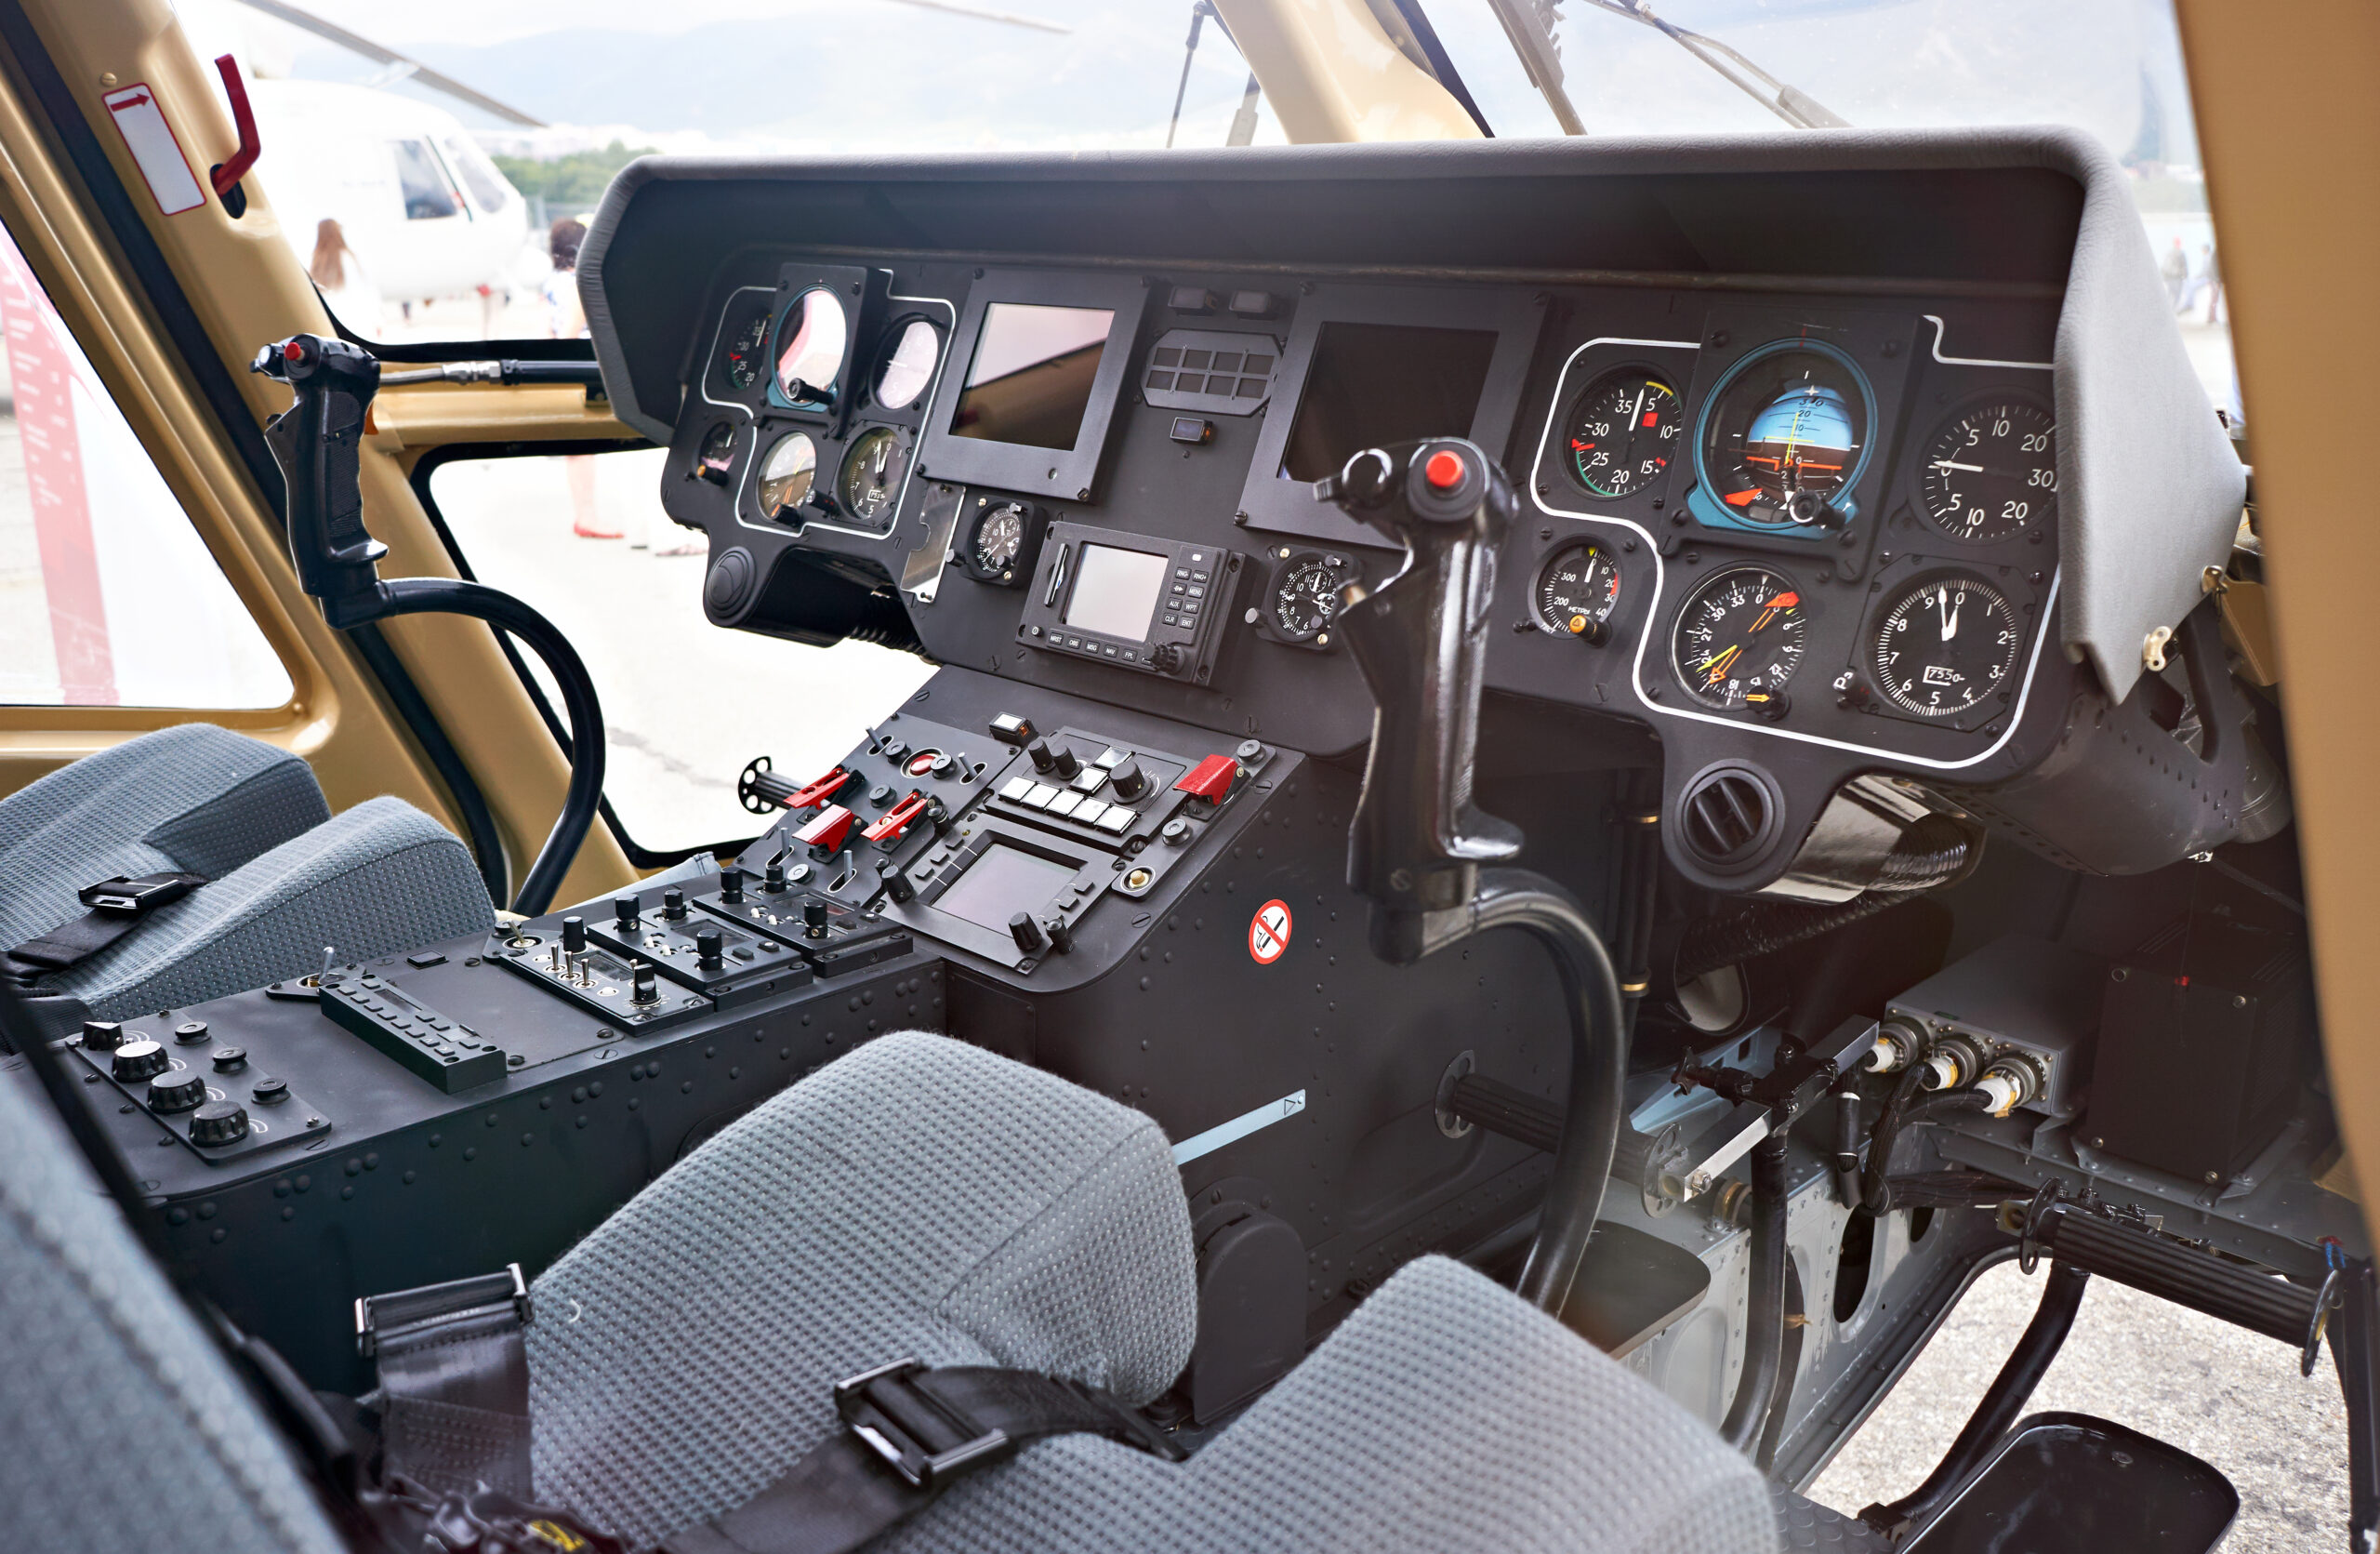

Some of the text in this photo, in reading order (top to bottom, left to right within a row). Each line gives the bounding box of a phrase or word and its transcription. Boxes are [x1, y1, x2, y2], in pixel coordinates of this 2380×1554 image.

[1615, 400, 1633, 414] 35
[1646, 398, 1656, 411] 5
[1592, 423, 1609, 436] 30
[1659, 425, 1673, 439] 10
[1992, 419, 2010, 436] 10
[1965, 429, 1980, 445] 5
[2020, 433, 2047, 452] 20
[860, 461, 866, 470] 8
[1591, 452, 1610, 466] 25
[1641, 460, 1654, 474] 15
[1610, 470, 1630, 484] 20
[2028, 469, 2054, 487] 30
[854, 482, 860, 490] 7
[1948, 494, 1963, 511] 5
[868, 506, 874, 514] 5
[2002, 500, 2029, 519] 20
[1966, 508, 1985, 525] 10
[1601, 566, 1609, 575] 10
[1561, 573, 1577, 582] 300
[1605, 578, 1614, 588] 20
[1296, 583, 1303, 591] 10
[1554, 596, 1569, 606] 200
[1605, 593, 1615, 602] 30
[1730, 595, 1745, 607] 33
[1755, 594, 1764, 604] 0
[1924, 596, 1935, 609] 9
[1955, 591, 1965, 604] 0
[1290, 606, 1295, 615] 8
[1595, 608, 1606, 617] 40
[1711, 607, 1726, 621] 30
[1987, 604, 1992, 617] 1
[1303, 621, 1308, 630] 6
[1897, 618, 1907, 632] 8
[1701, 628, 1712, 642] 27
[1997, 631, 2009, 644] 2
[1700, 649, 1712, 664] 24
[1889, 651, 1900, 665] 7
[1768, 663, 1782, 675] 12
[1989, 665, 2001, 679] 3
[1728, 679, 1739, 689] 18
[1902, 678, 1912, 692] 6
[1929, 691, 1941, 705] 5
[1963, 687, 1973, 700] 4
